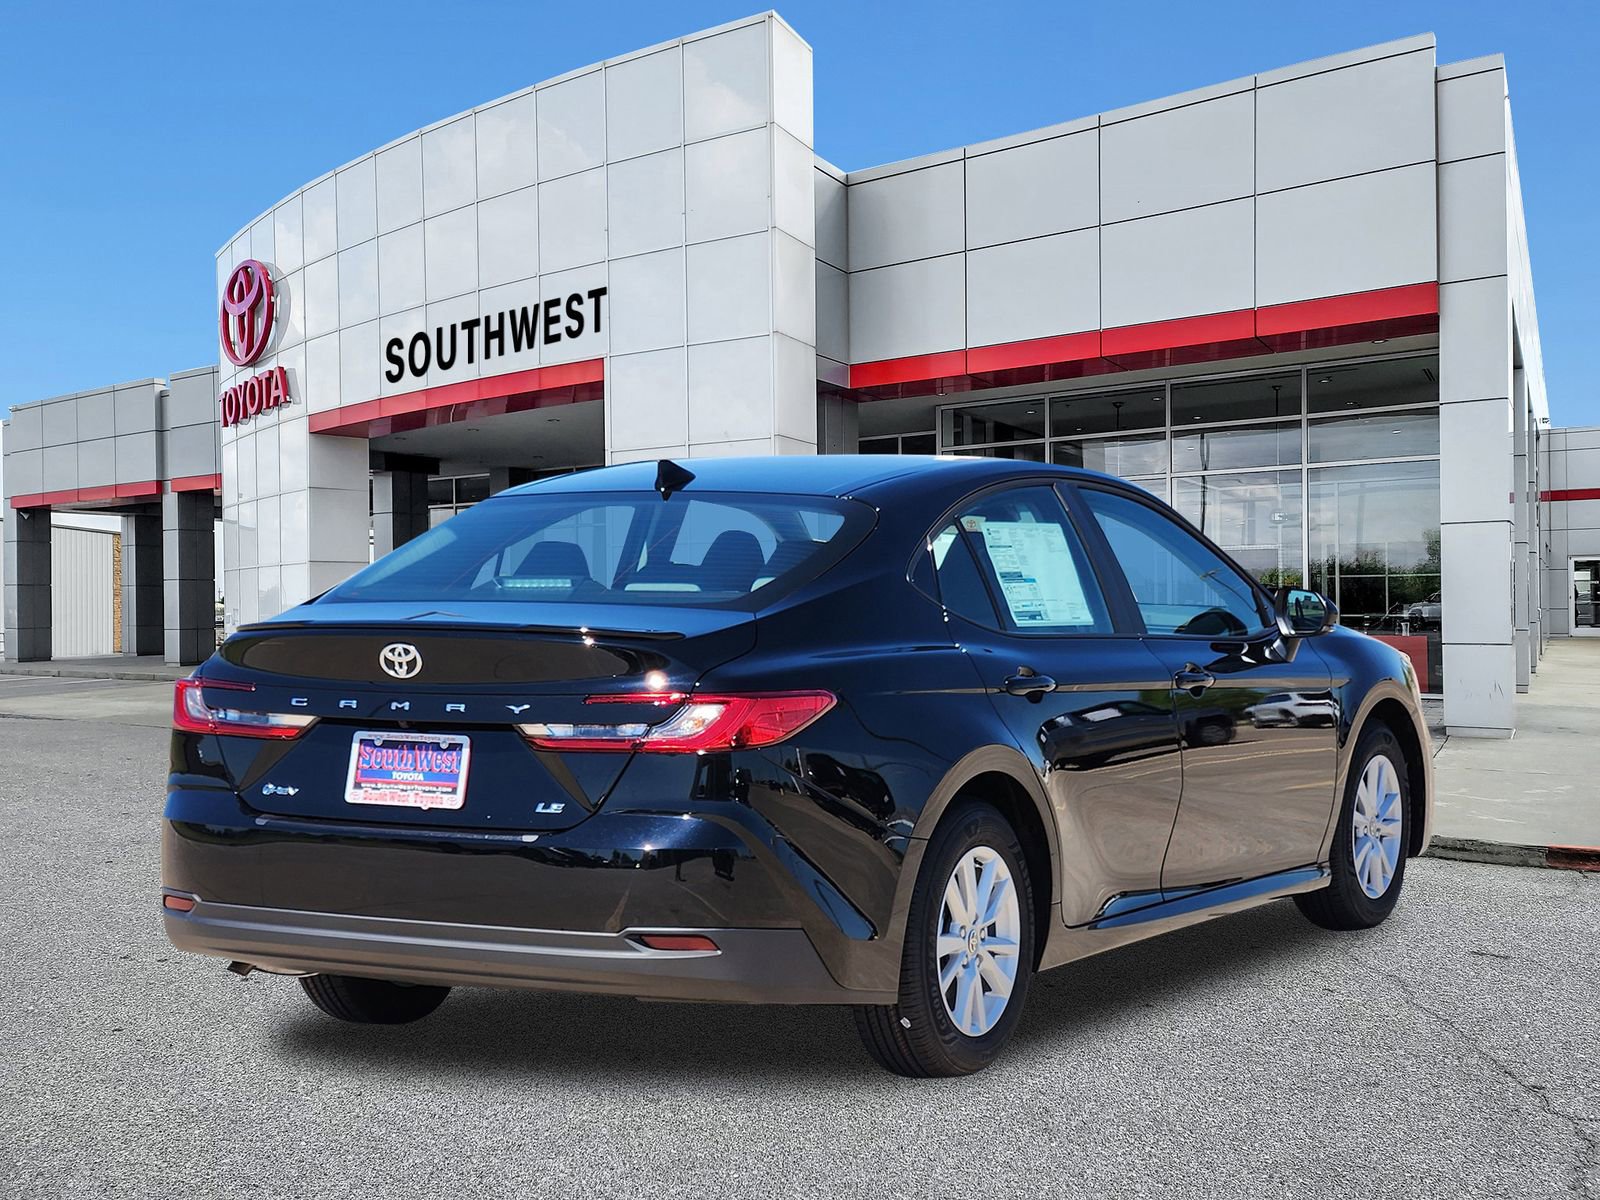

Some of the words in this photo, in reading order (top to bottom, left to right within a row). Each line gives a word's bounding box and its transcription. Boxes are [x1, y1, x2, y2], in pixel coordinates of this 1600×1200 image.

[385, 287, 608, 383] SOUTHWEST
[219, 366, 289, 428] TOYOTA
[290, 697, 531, 714] CAMRY
[391, 771, 424, 781] TOYOTA
[535, 802, 566, 814] LE
